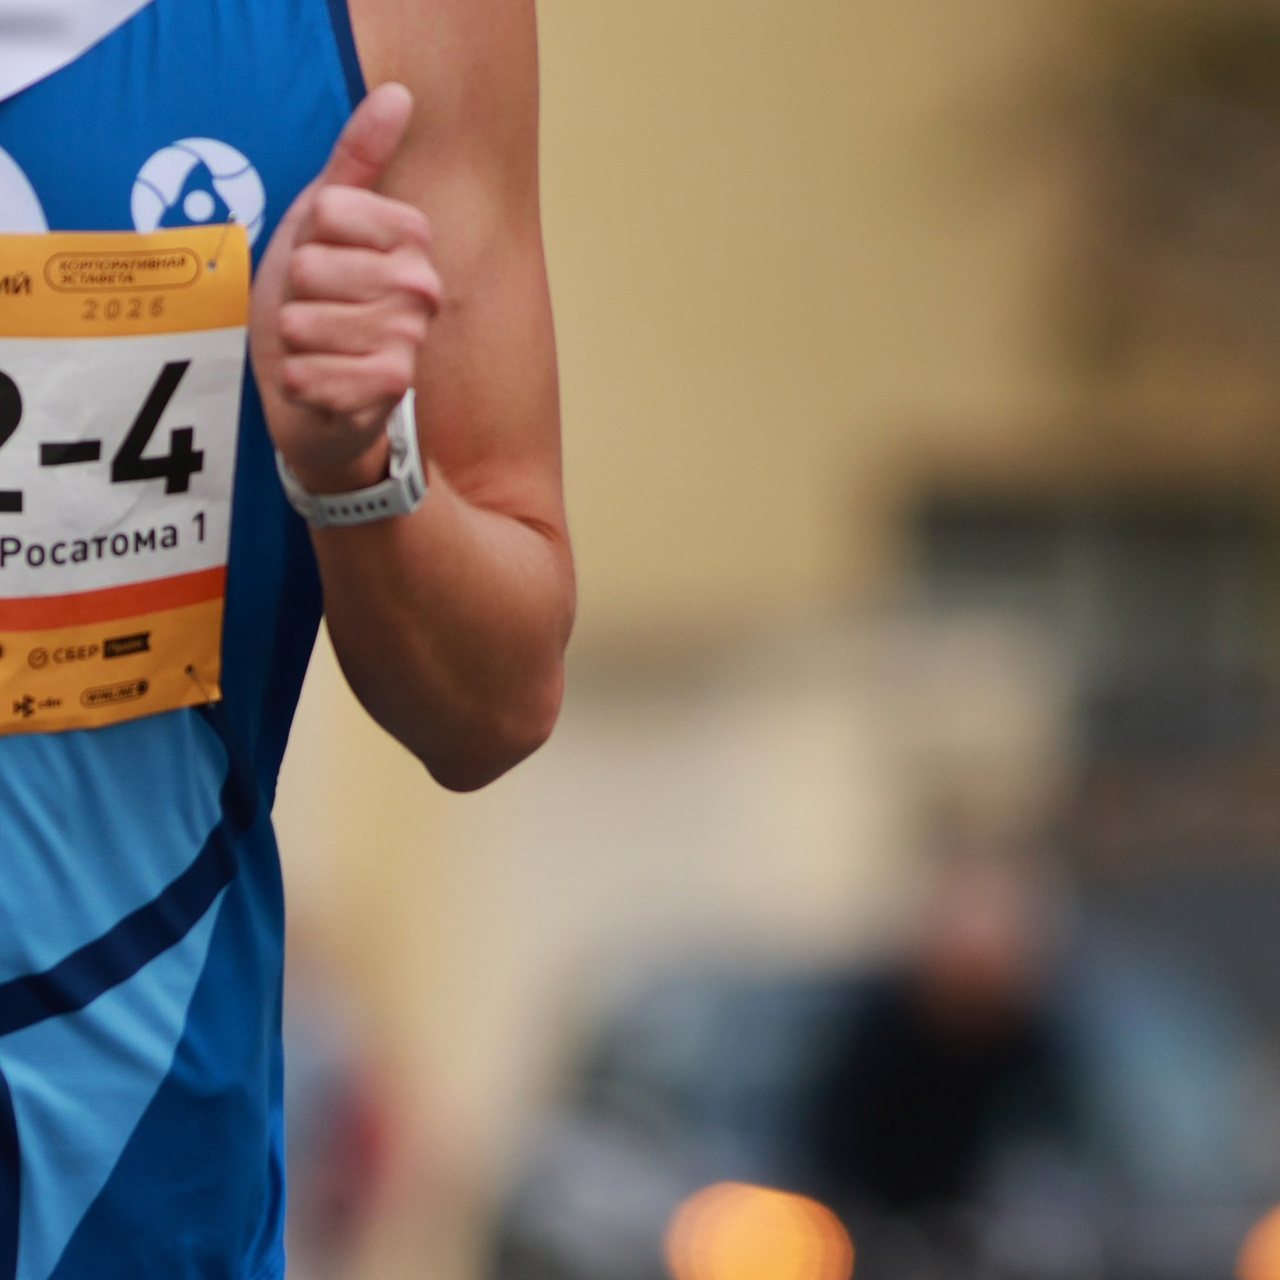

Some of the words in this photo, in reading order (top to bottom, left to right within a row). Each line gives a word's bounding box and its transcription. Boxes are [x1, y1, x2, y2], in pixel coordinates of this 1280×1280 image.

[59, 254, 187, 271] КОРПОРАТИВНАЯ
[61, 270, 134, 285] ЭСТАФЕТА
[191, 510, 205, 544] 1
[53, 643, 98, 664] СБЕР
